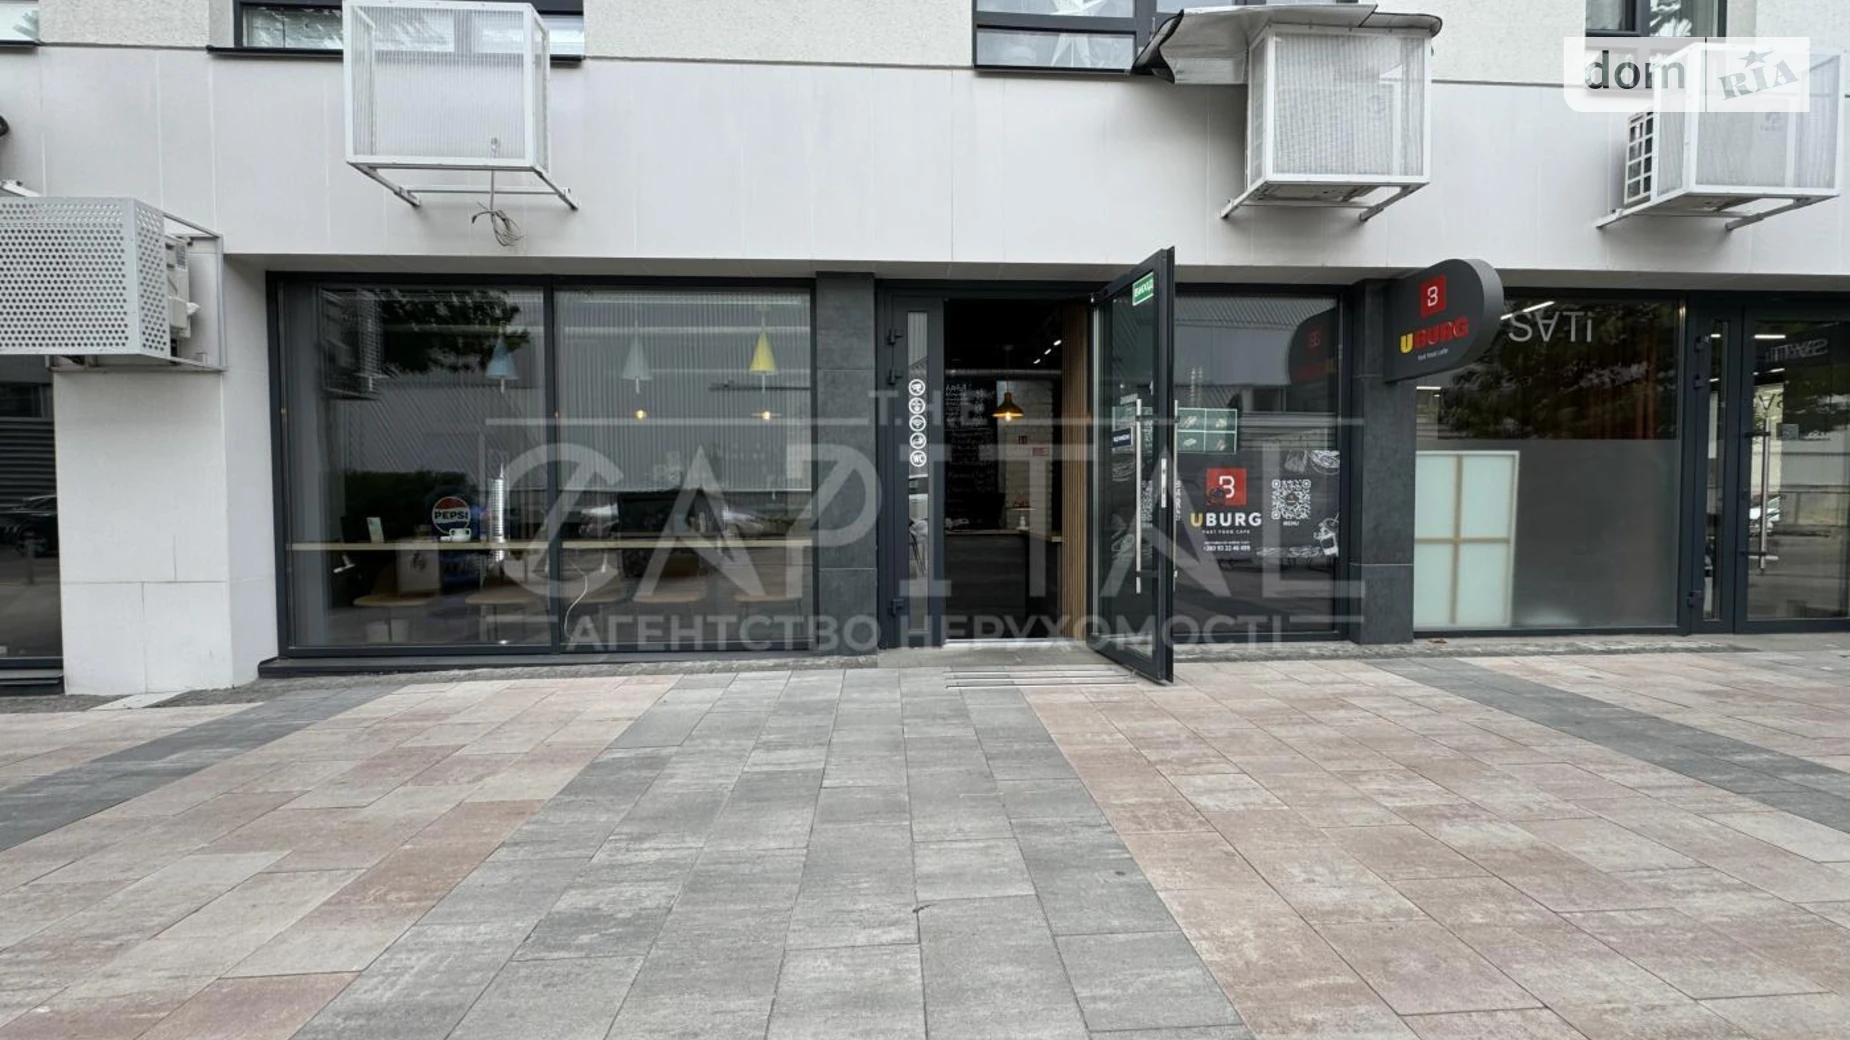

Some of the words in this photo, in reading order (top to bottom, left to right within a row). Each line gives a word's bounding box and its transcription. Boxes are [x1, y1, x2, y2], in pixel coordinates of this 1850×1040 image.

[1400, 315, 1469, 354] UBURG
[911, 452, 926, 463] WC
[434, 510, 469, 520] PEPSI
[1190, 512, 1262, 527] UBURG
